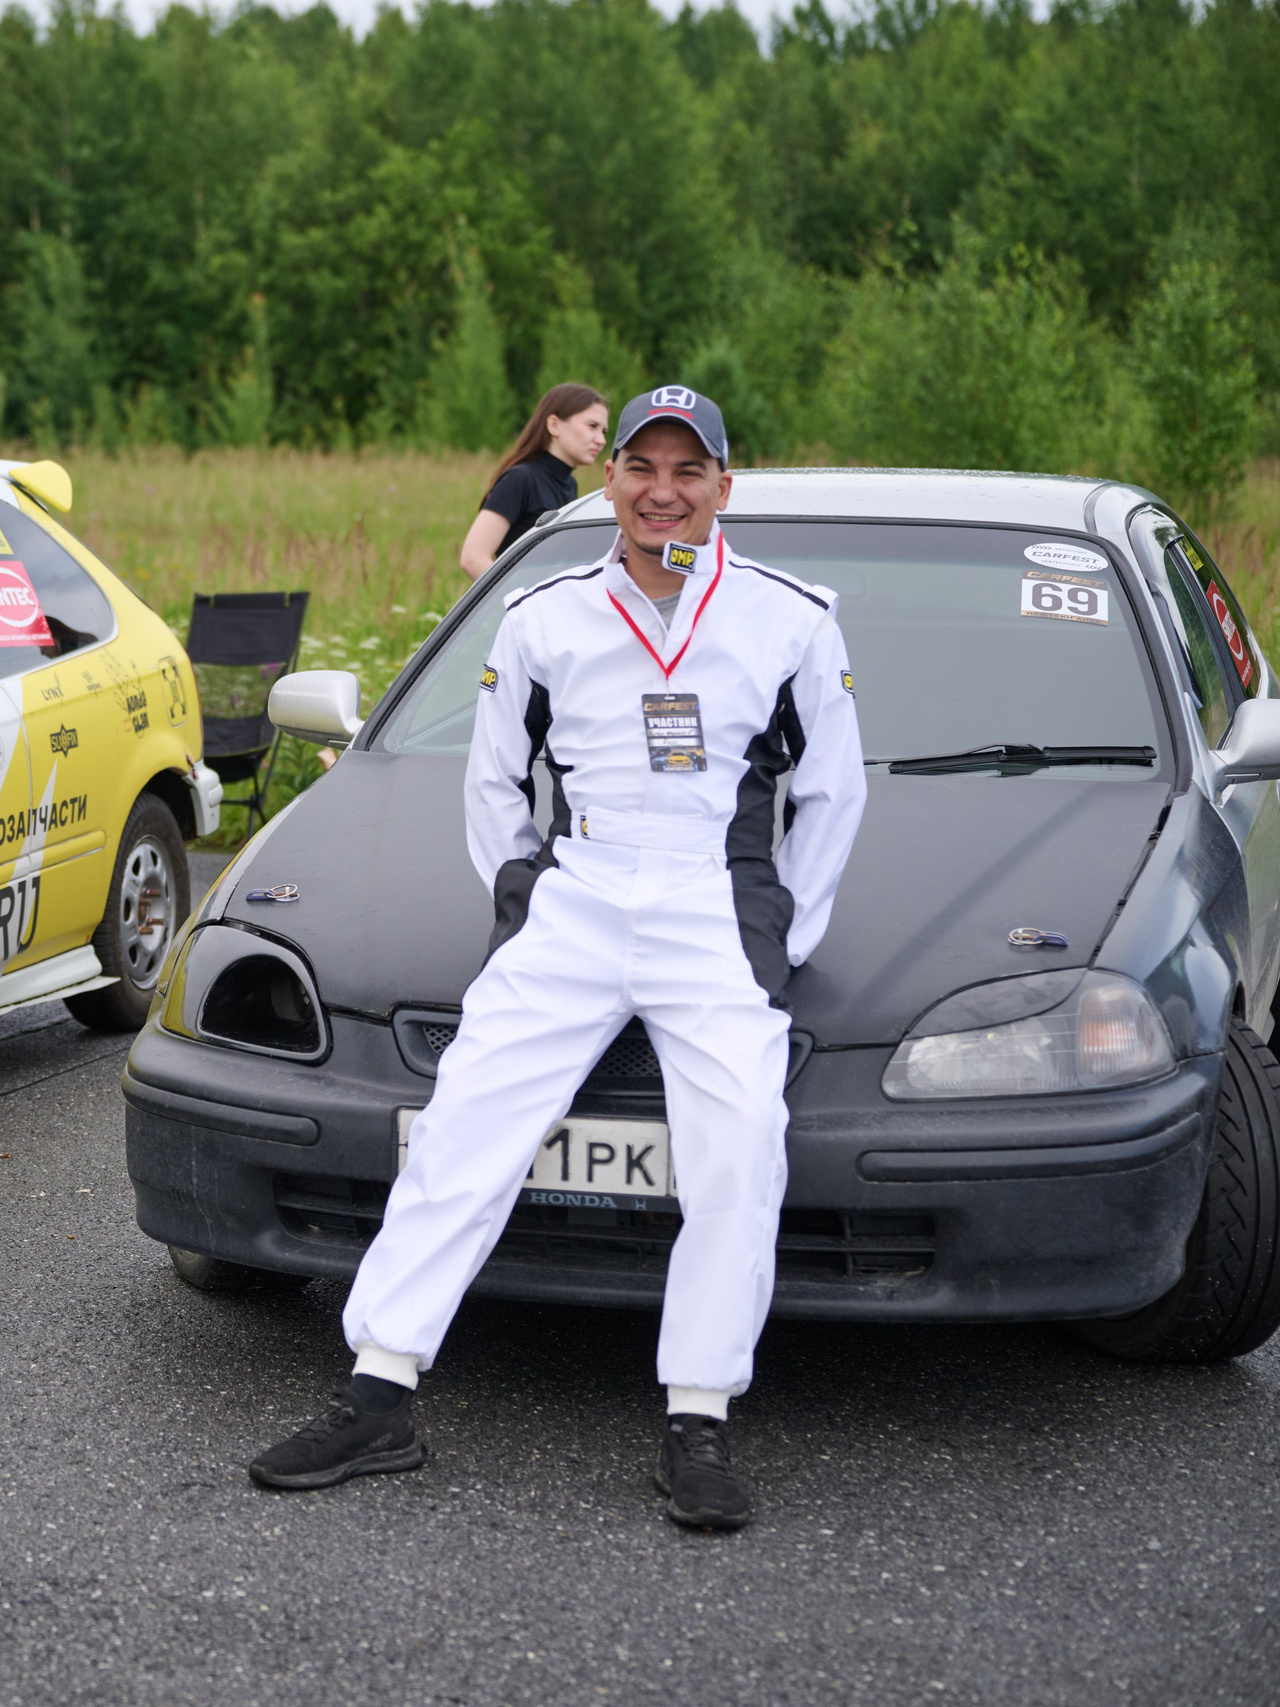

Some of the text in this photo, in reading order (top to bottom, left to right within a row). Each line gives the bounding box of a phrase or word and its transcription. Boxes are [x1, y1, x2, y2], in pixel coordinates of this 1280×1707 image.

[671, 548, 696, 567] OMP
[1032, 551, 1100, 564] CARFEST
[1027, 571, 1104, 588] CARFEST
[1032, 583, 1098, 616] 69
[481, 670, 497, 686] MP
[644, 702, 698, 712] CARFEST
[647, 716, 698, 728] УЧАСТНИК
[530, 1191, 618, 1209] HONDA
